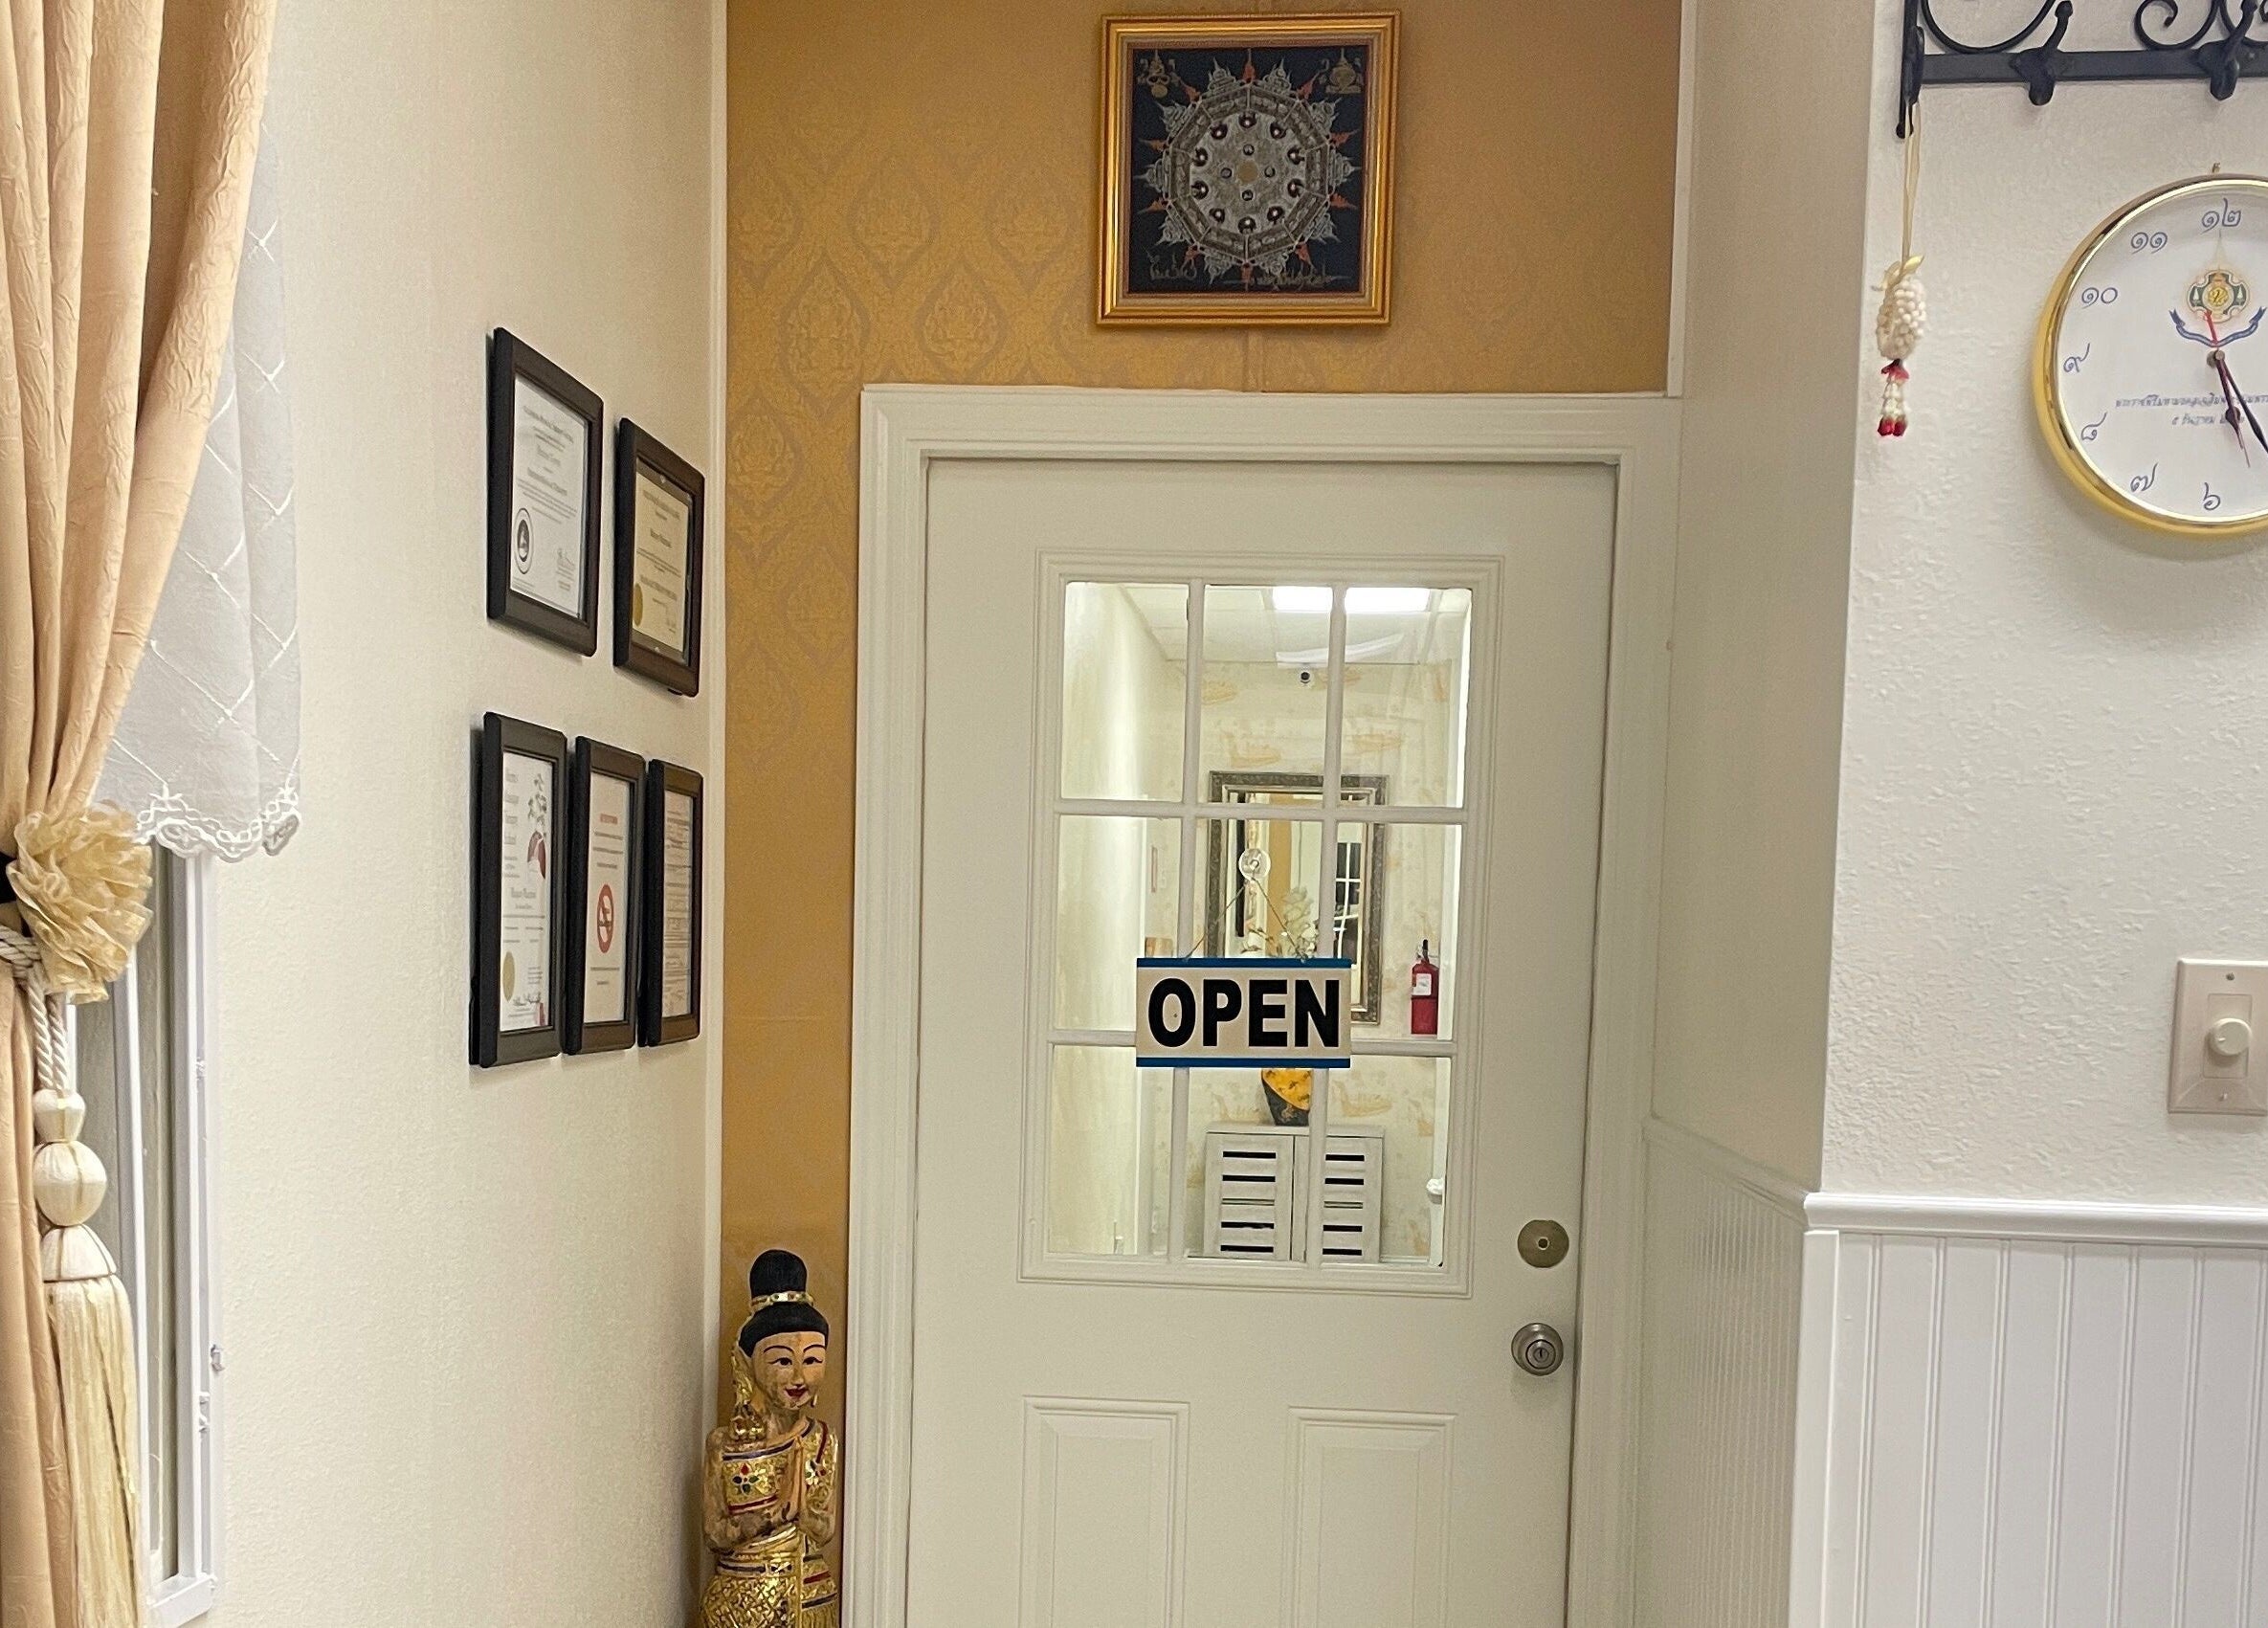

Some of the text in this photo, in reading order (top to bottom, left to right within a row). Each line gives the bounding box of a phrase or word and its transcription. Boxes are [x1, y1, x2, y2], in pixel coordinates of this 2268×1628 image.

[2201, 197, 2242, 235] ๑๒
[2130, 231, 2168, 255] ๑๑
[2202, 481, 2221, 511] ๖
[1147, 977, 1340, 1048] OPEN
